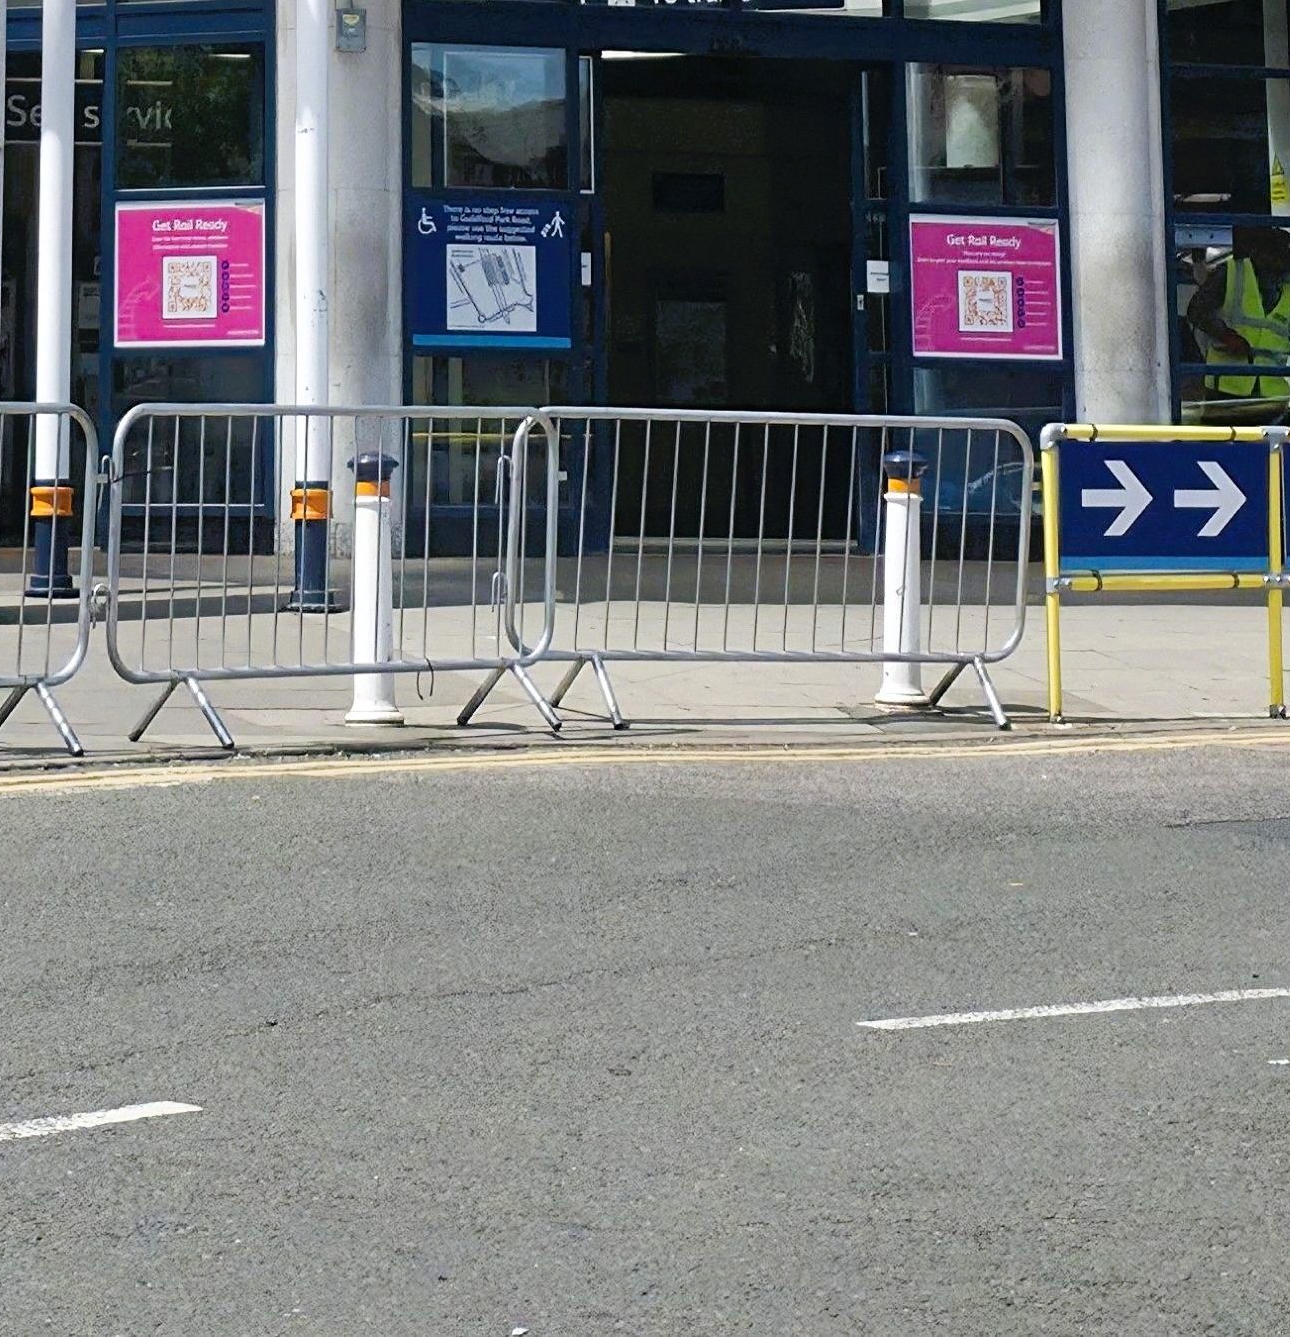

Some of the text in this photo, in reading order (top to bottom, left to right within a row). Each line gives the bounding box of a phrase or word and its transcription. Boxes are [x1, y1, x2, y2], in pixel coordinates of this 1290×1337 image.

[152, 218, 228, 232] Get Rail Ready
[946, 233, 1022, 250] Get Rail Ready
